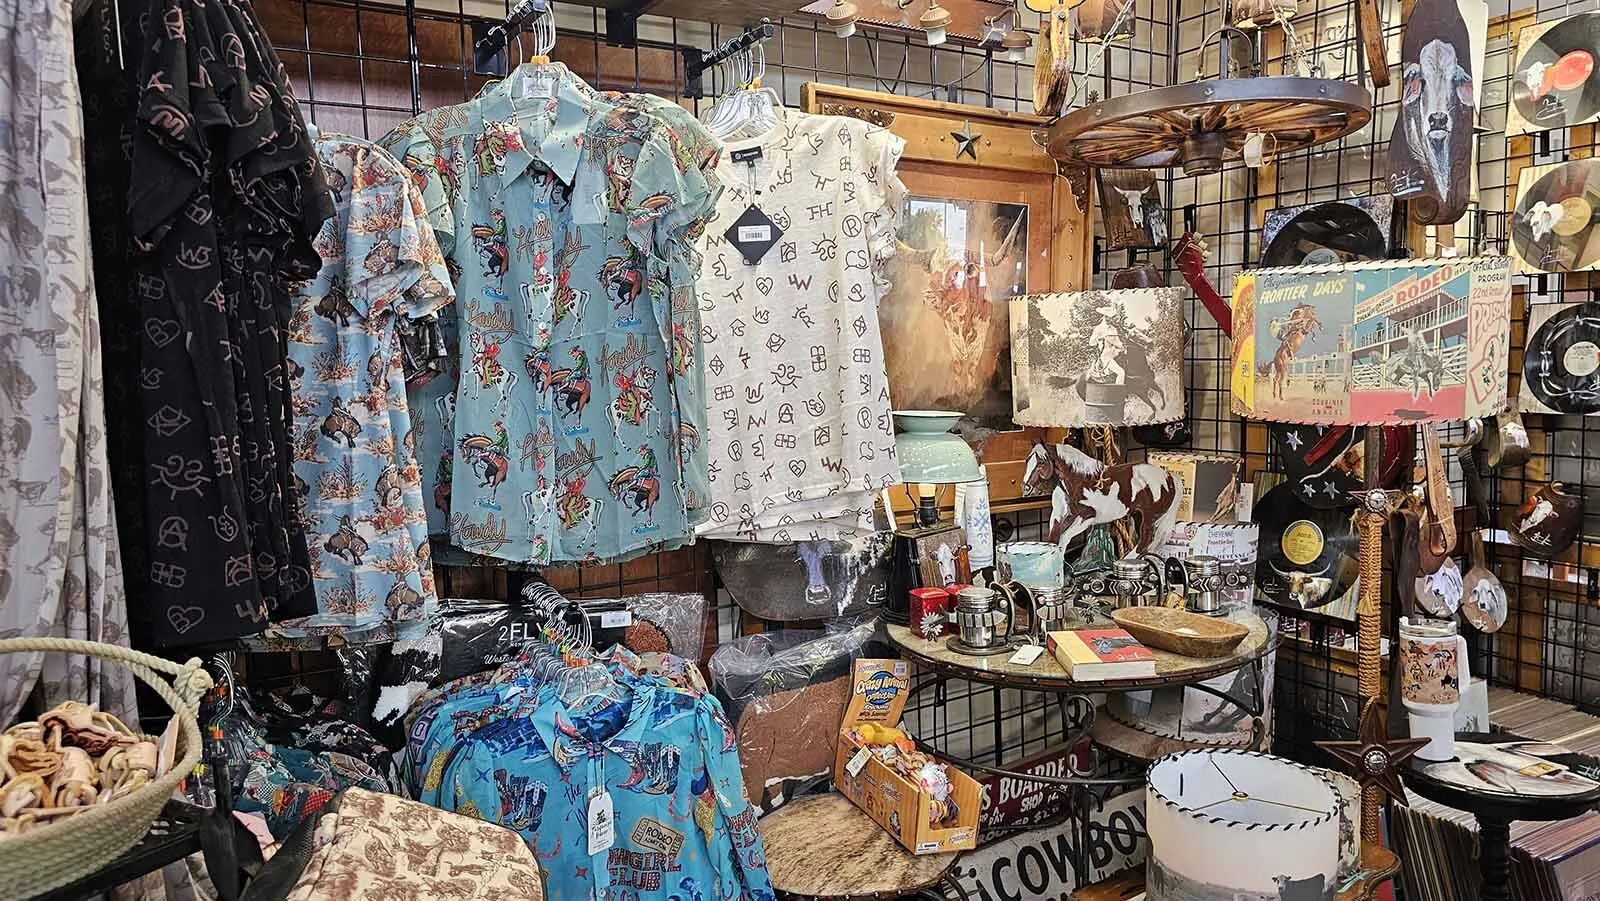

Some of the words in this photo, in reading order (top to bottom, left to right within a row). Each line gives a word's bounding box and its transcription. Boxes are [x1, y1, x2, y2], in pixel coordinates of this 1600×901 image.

[1259, 285, 1308, 305] FRONTIER
[1313, 278, 1347, 297] DAYS
[1396, 266, 1453, 304] RODEO
[855, 679, 882, 695] Crazy
